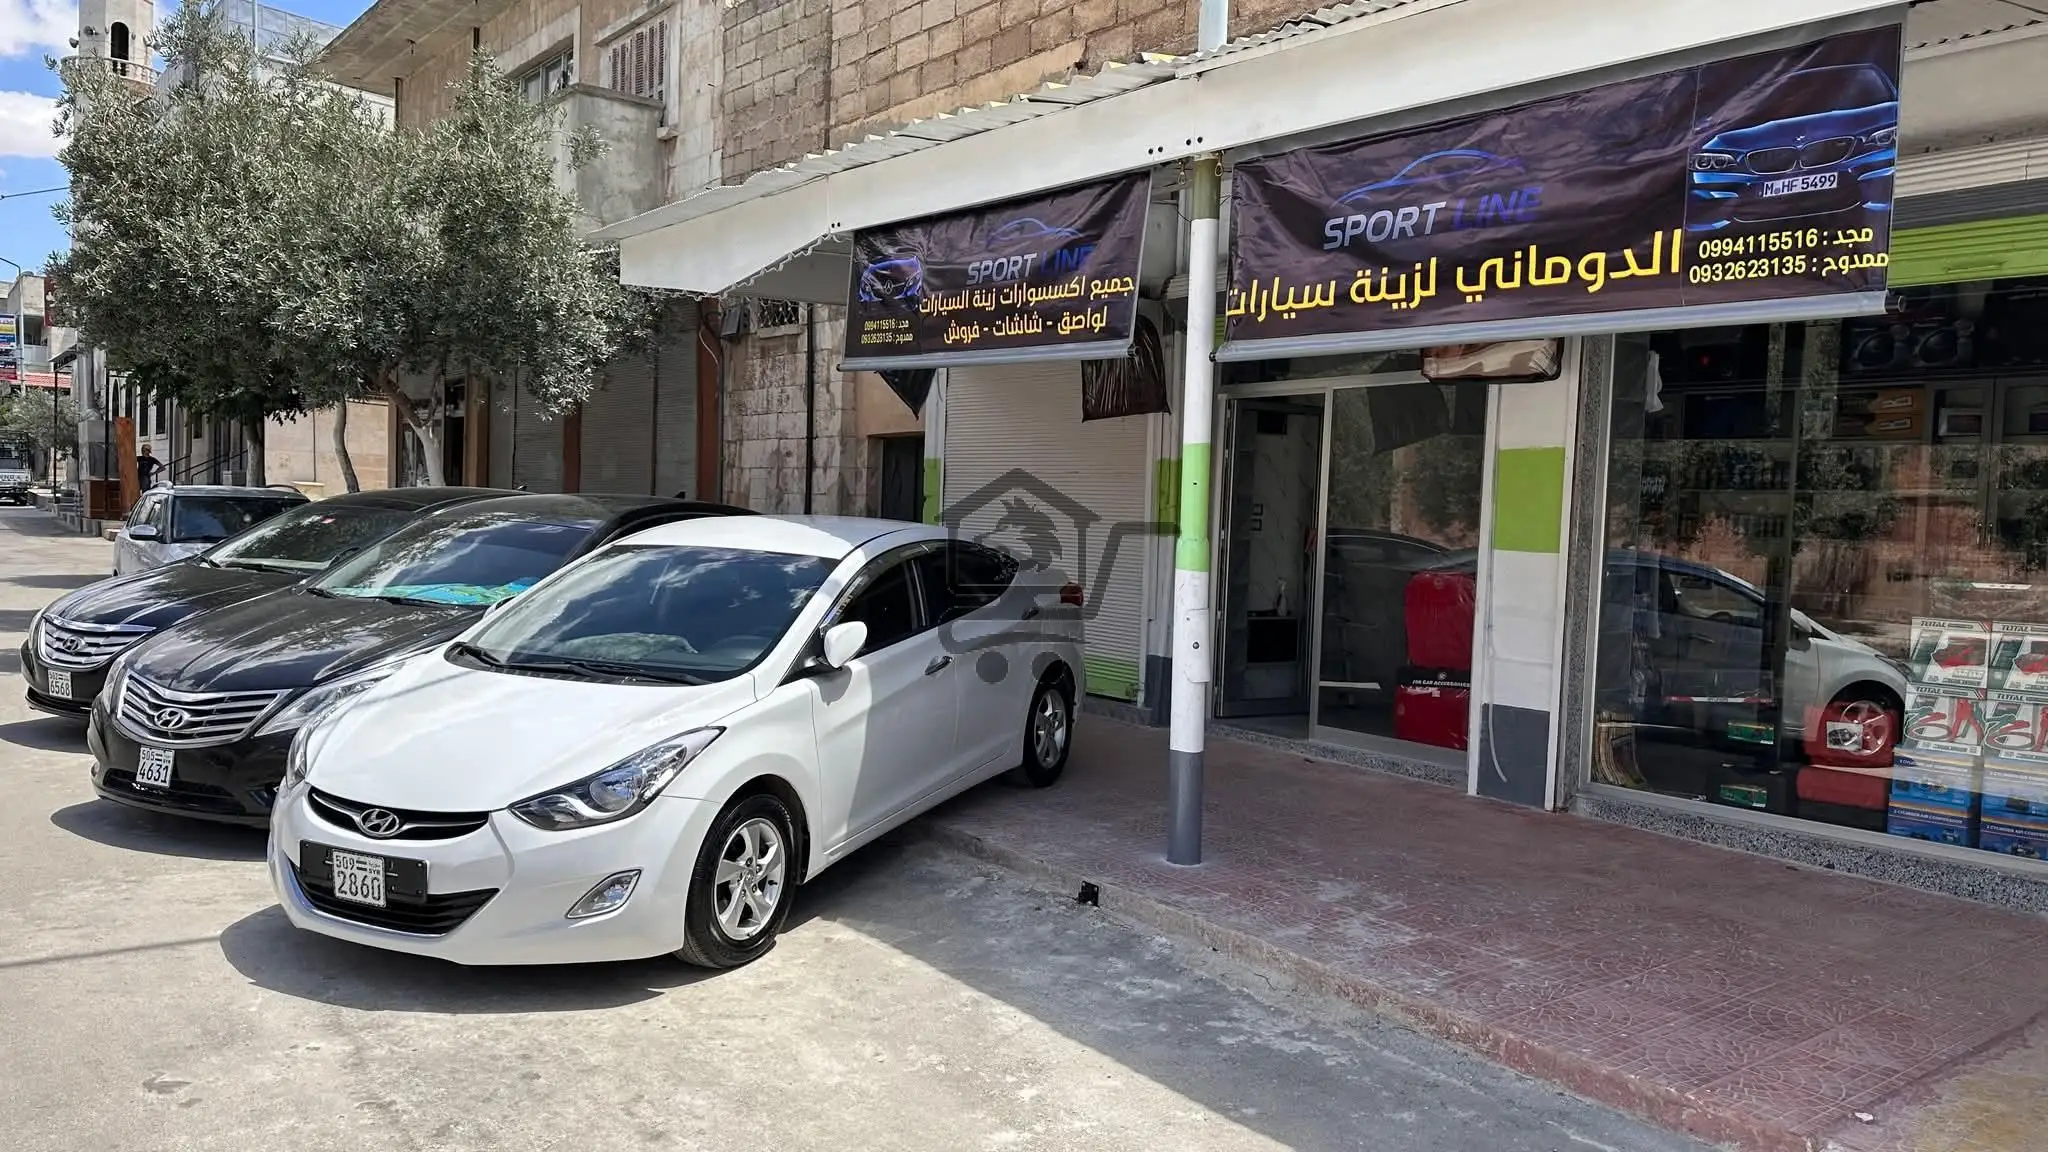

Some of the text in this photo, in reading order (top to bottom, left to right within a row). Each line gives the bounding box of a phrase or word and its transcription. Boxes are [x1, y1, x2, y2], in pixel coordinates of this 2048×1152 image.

[1781, 178, 1799, 193] HF
[1801, 174, 1837, 190] 5499
[1323, 186, 1543, 250] SPORT LINE
[1698, 228, 1818, 259] 0994115516
[1832, 228, 1874, 248] مجد
[966, 252, 1038, 286] SPORT
[1226, 228, 1683, 322] الدوماني لزينة سيارات
[1689, 254, 1807, 284] 0932623135
[1821, 252, 1889, 277] ممدوح
[919, 275, 1135, 317] جميع اكسسوارات زينة السيارات
[944, 319, 980, 344] فروش
[992, 311, 1043, 336] شاشات
[1057, 306, 1108, 335] لواصق
[1920, 620, 1949, 628] TOTAL
[2002, 624, 2030, 632] TOTAL
[51, 680, 70, 697] 6568
[1916, 686, 1944, 694] TOTAL
[141, 750, 155, 761] 505
[138, 761, 169, 784] 4631
[335, 855, 355, 870] 509
[337, 870, 381, 901] 2860
